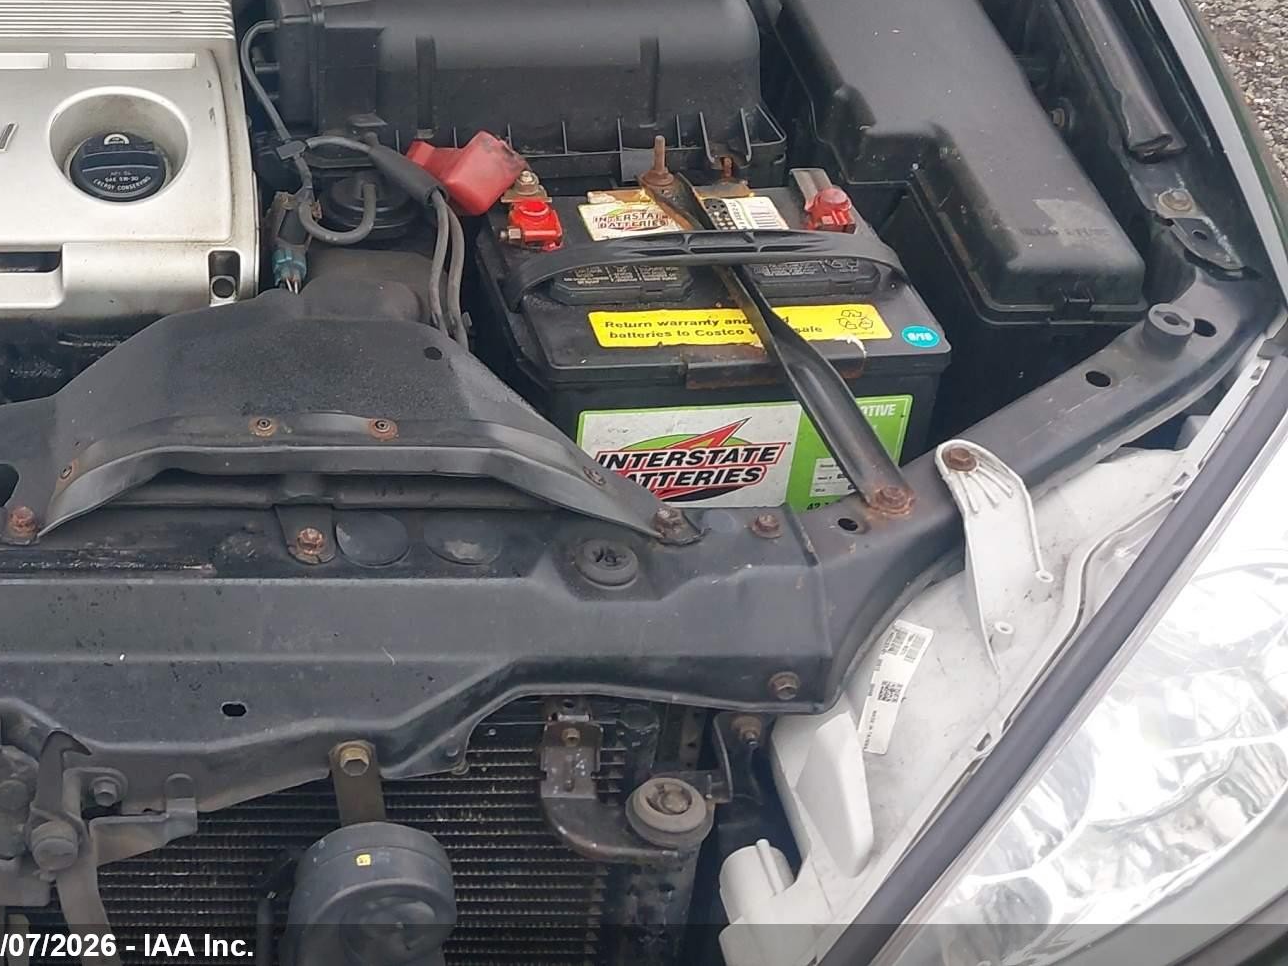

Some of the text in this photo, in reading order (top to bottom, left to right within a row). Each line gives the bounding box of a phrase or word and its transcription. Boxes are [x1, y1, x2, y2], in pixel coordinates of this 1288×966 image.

[657, 318, 720, 328] warranty
[610, 329, 672, 339] batteries
[677, 328, 690, 337] to
[695, 328, 745, 337] Costco
[598, 445, 780, 470] INTERSTATE
[624, 466, 762, 489] ATTERIES
